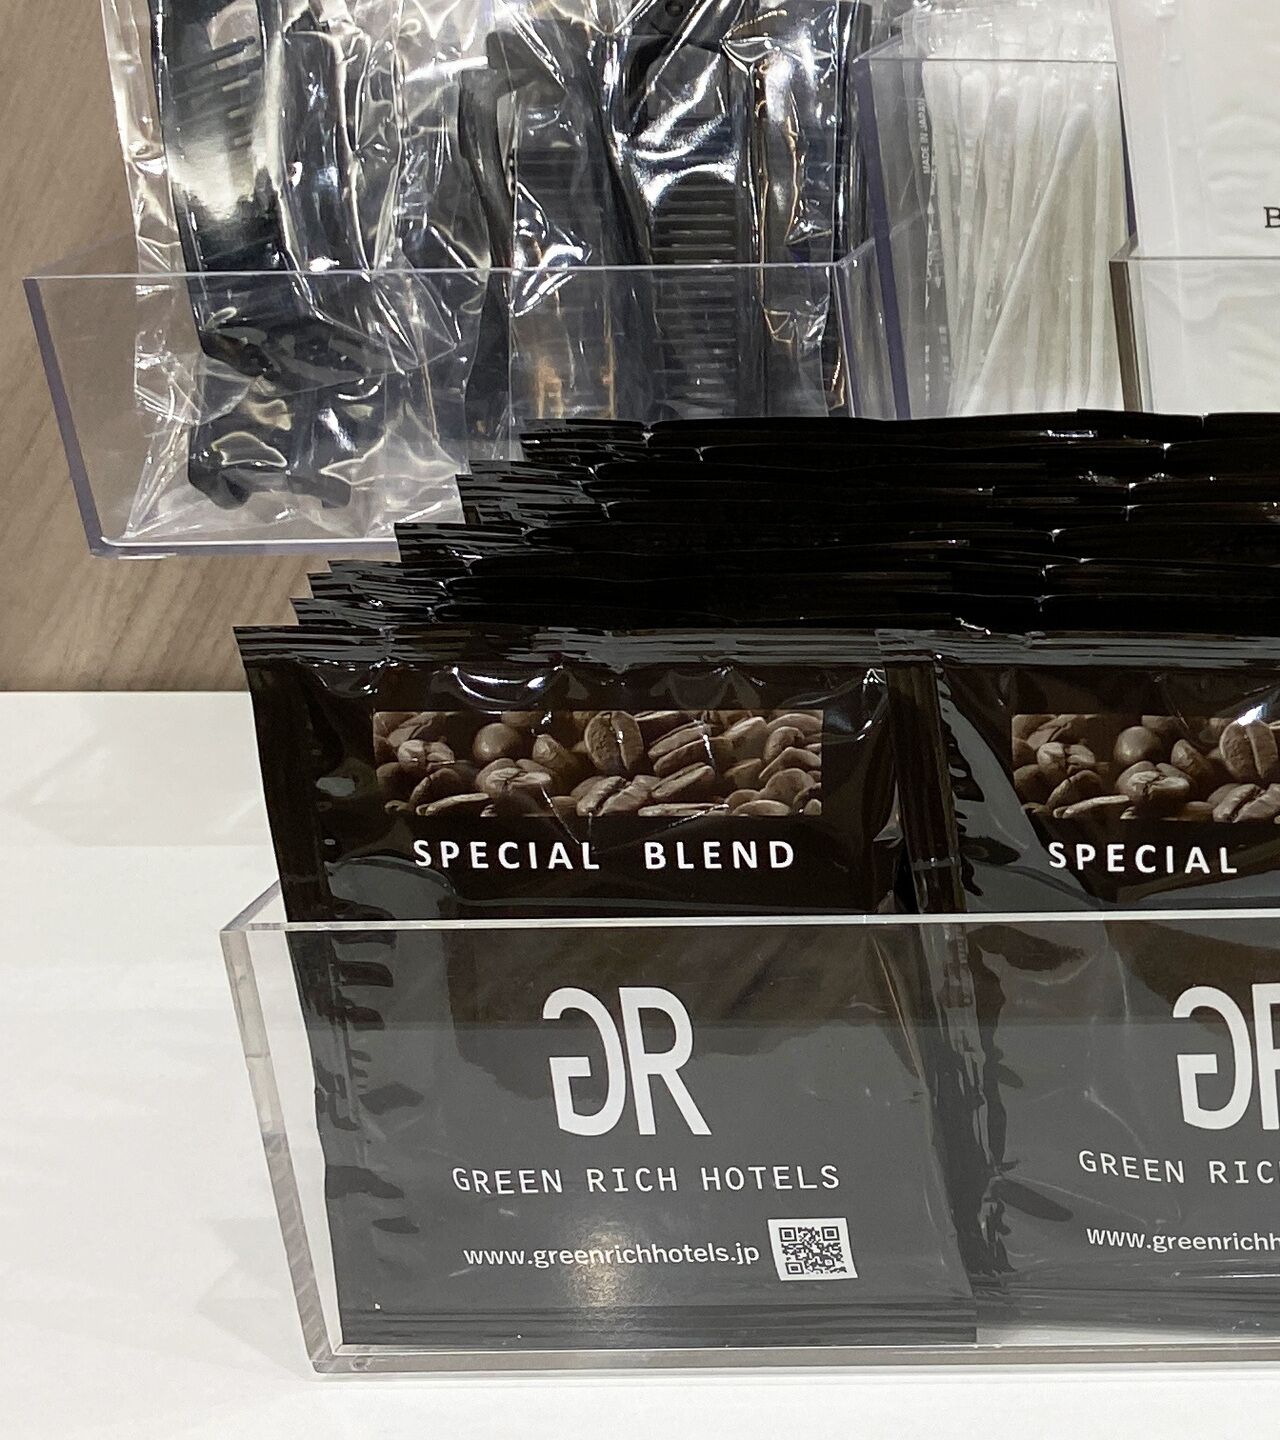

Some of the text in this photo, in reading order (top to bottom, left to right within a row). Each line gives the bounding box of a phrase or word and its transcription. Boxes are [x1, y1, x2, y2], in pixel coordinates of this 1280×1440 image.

[413, 839, 796, 871] SPECIAL BLEND
[1048, 841, 1239, 875] SPECIAL
[451, 1164, 841, 1196] GREEN RICH HOTELS
[1077, 1149, 1186, 1185] GREEN
[463, 1243, 761, 1270] www.greenrichhotels.jp
